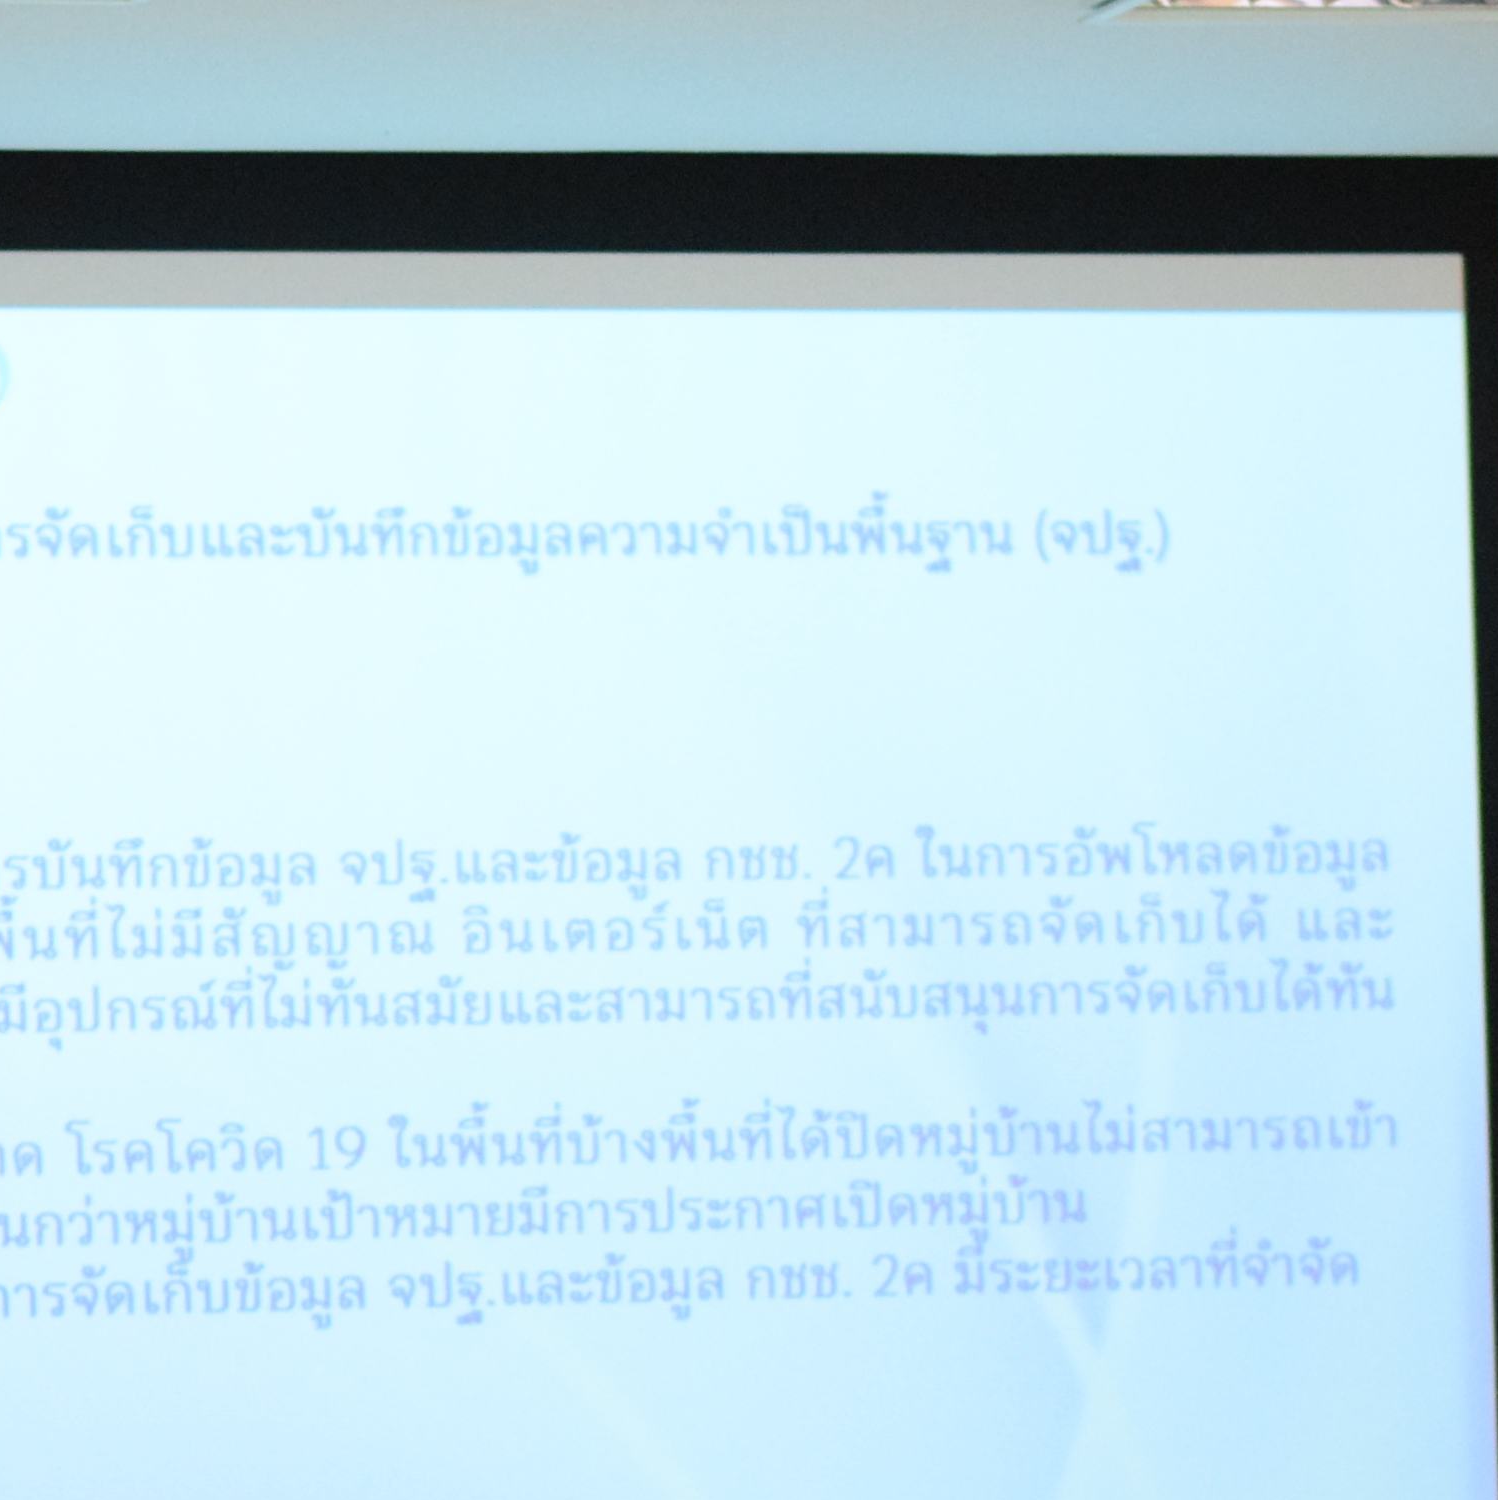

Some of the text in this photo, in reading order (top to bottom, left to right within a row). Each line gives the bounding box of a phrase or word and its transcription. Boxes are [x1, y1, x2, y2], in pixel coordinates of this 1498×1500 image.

[1035, 509, 1171, 574] (จปฐ.)
[705, 844, 810, 880] กชช.
[834, 835, 895, 880] 2ค
[1299, 908, 1389, 941] และ
[310, 1125, 367, 1170] 19
[748, 1263, 851, 1299] กชช.
[874, 1254, 934, 1298] 2ค
